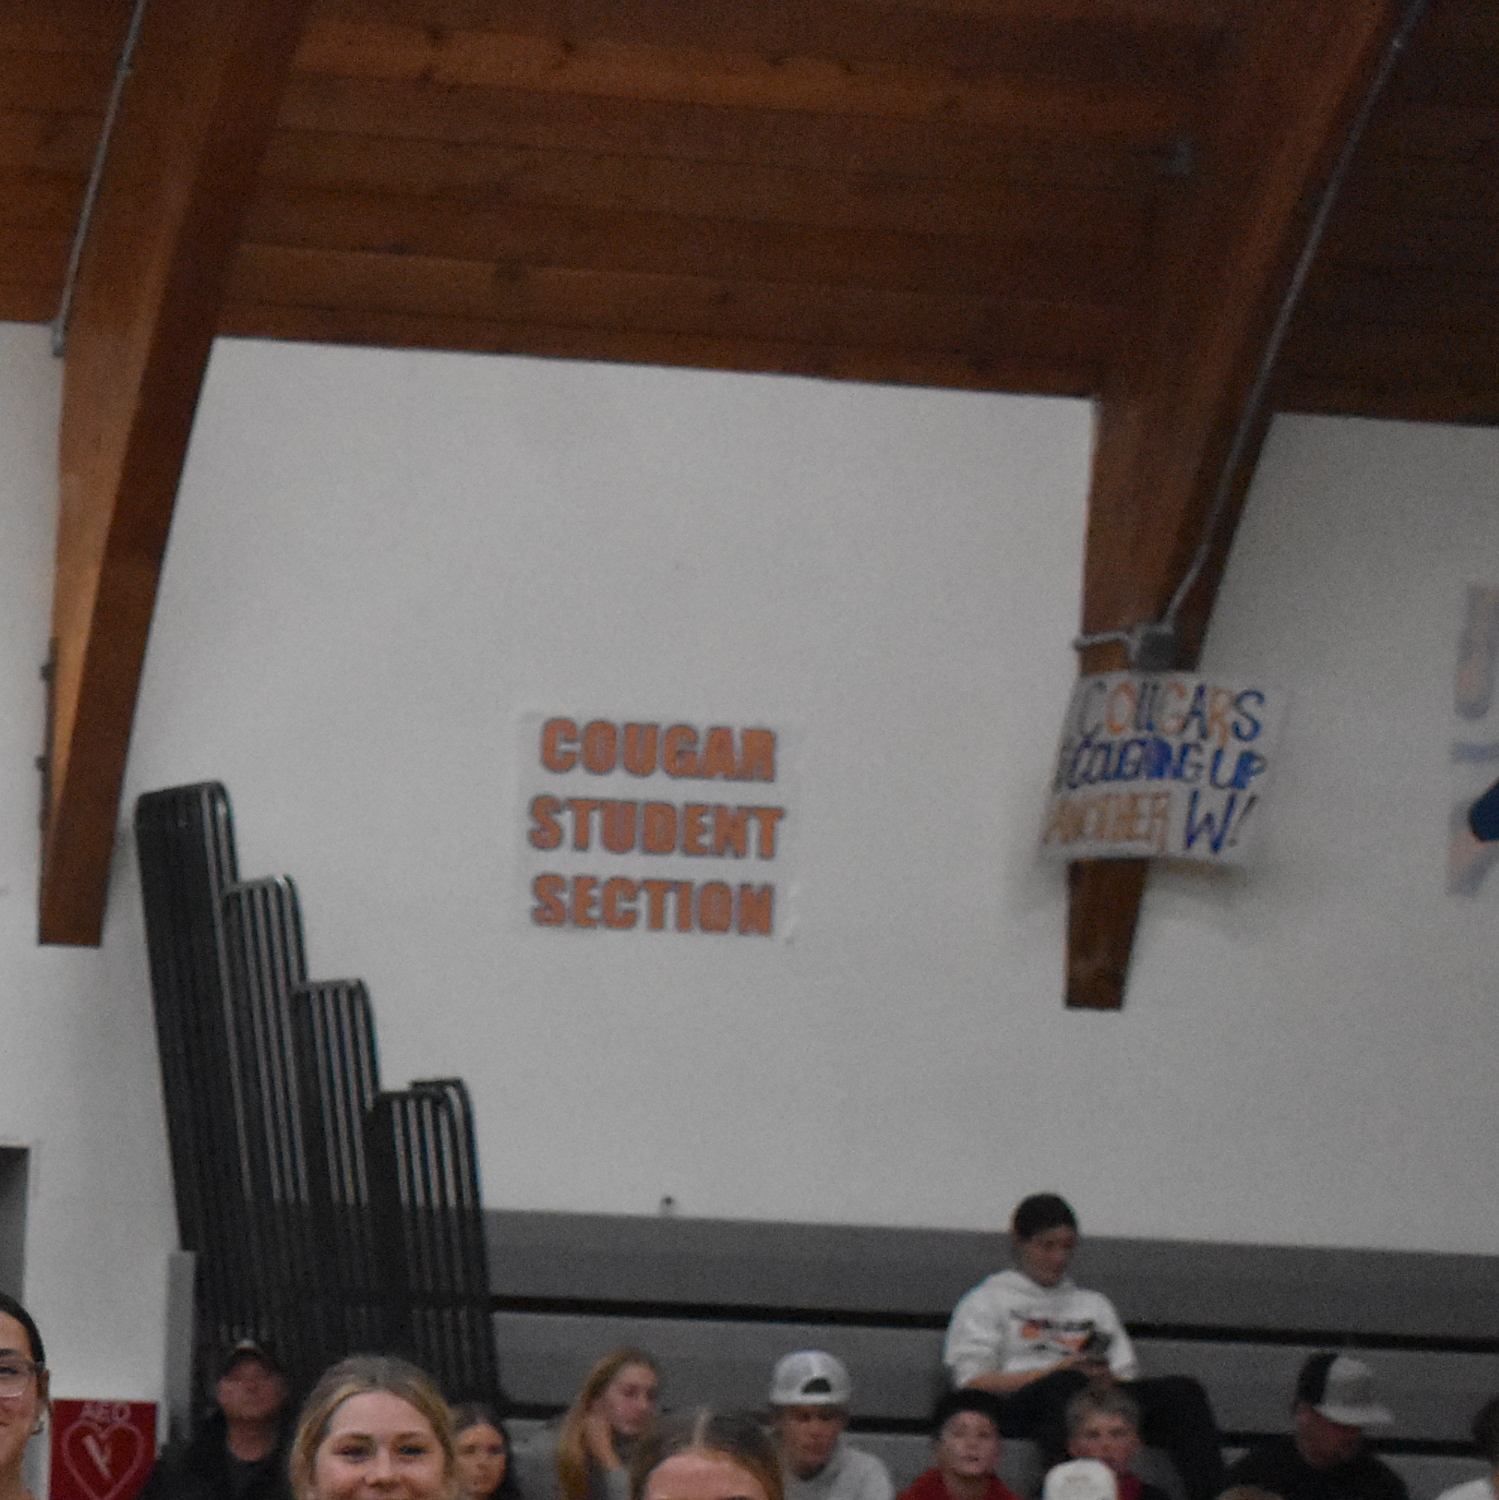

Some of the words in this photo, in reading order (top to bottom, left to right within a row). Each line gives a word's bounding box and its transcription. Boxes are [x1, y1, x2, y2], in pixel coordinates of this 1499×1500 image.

[1079, 681, 1265, 745] COUGARS
[540, 717, 776, 783] COUGAR
[1210, 748, 1268, 790] UP
[528, 794, 786, 860] STUDENT
[532, 873, 775, 936] SECTION
